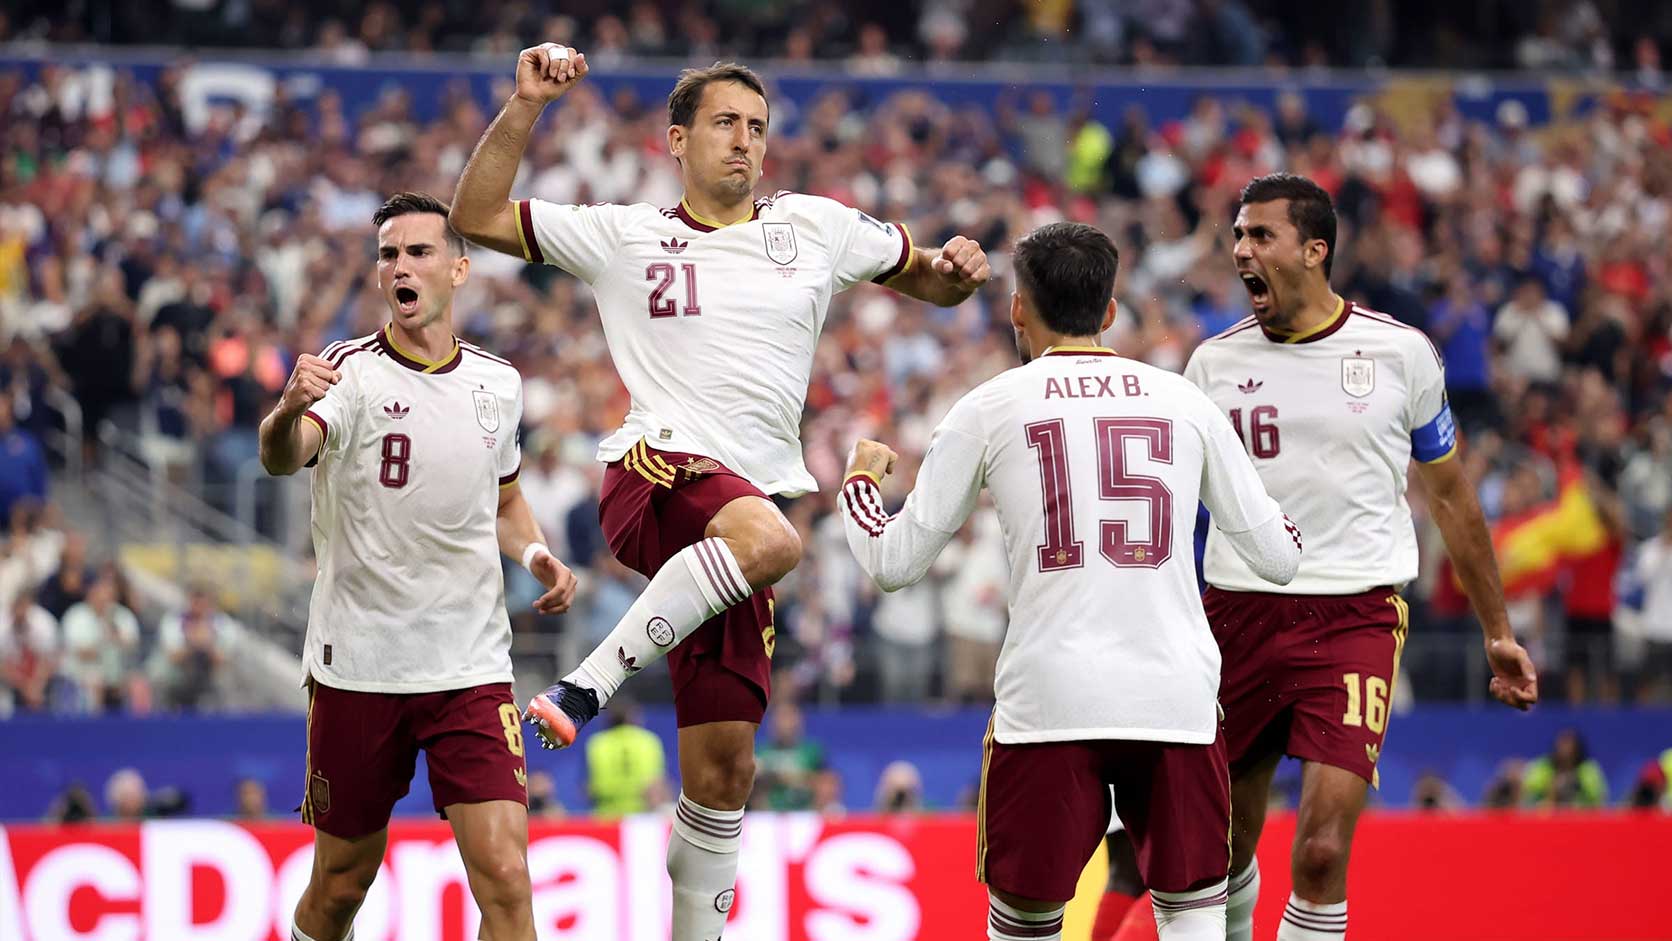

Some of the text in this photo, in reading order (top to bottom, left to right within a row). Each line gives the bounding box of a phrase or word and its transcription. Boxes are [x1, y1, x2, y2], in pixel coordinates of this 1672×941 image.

[646, 263, 701, 319] 21
[1045, 375, 1149, 399] ALEX B.
[379, 433, 411, 489] 8
[1024, 417, 1173, 573] 15
[498, 703, 523, 757] 8
[1343, 673, 1387, 735] 16
[0, 813, 922, 941] cDonald's
